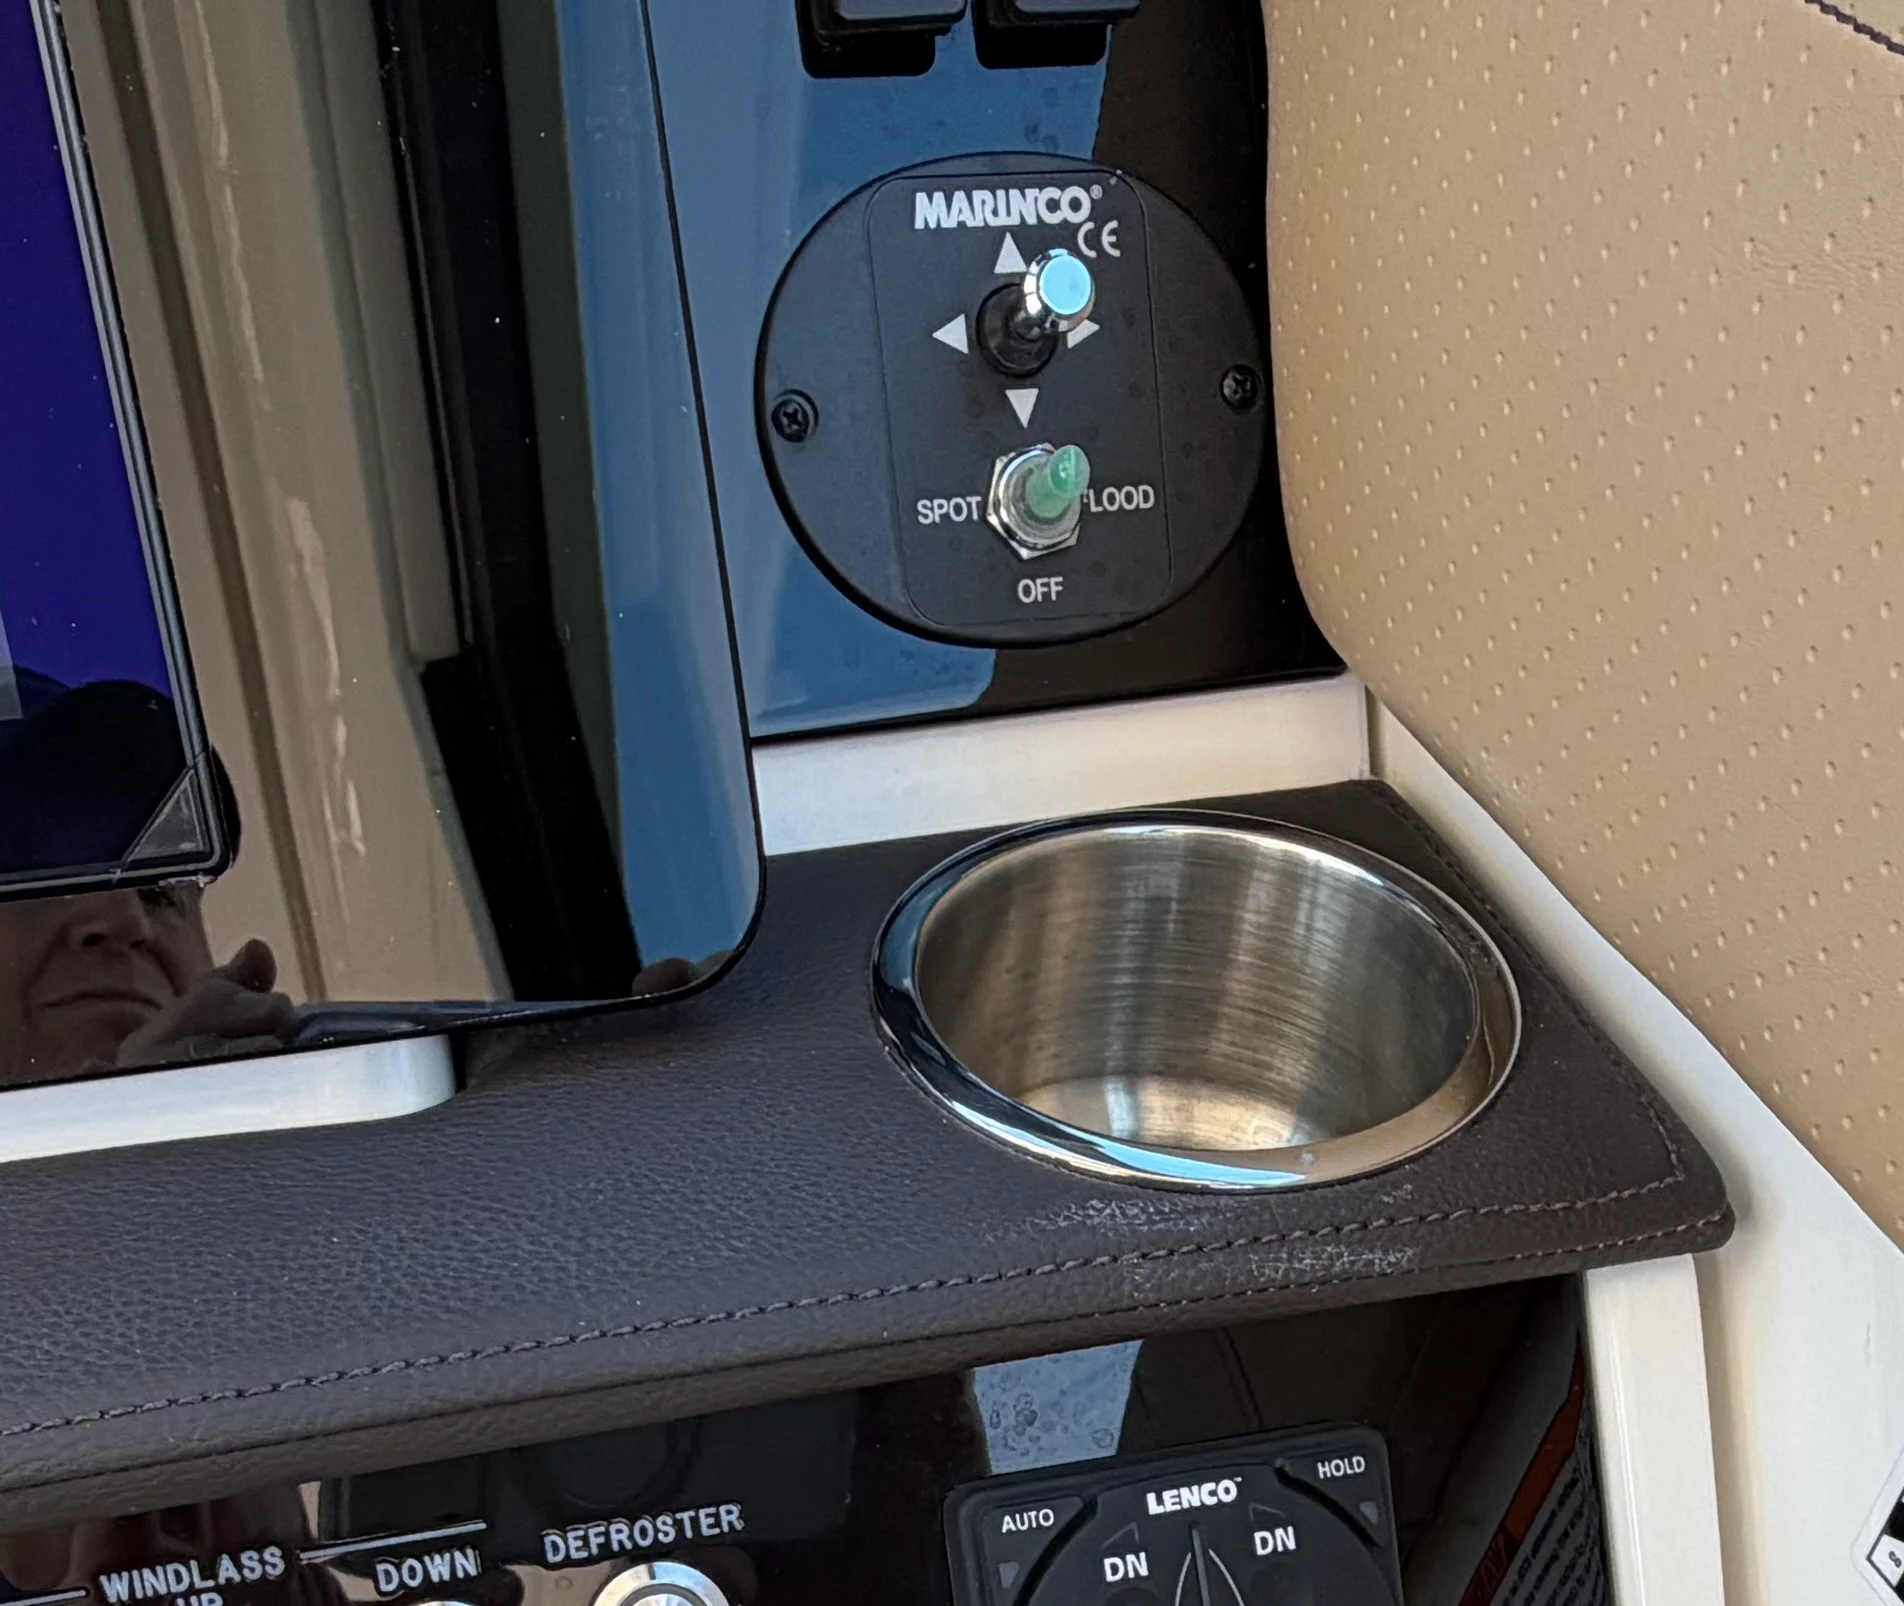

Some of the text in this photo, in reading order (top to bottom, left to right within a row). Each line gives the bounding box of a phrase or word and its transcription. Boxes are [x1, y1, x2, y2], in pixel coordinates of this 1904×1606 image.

[917, 496, 982, 525] SPOT
[1082, 485, 1155, 513] LOOD
[1018, 577, 1064, 604] OFF
[1317, 1455, 1366, 1480] HOLD
[1147, 1478, 1238, 1516] LENCO
[542, 1501, 746, 1566] DEFROSTER
[1001, 1508, 1055, 1536] AUTO
[1253, 1525, 1297, 1556] DN
[100, 1546, 288, 1606] WINDLASS
[376, 1549, 477, 1595] DOWN
[1103, 1551, 1150, 1583] DN
